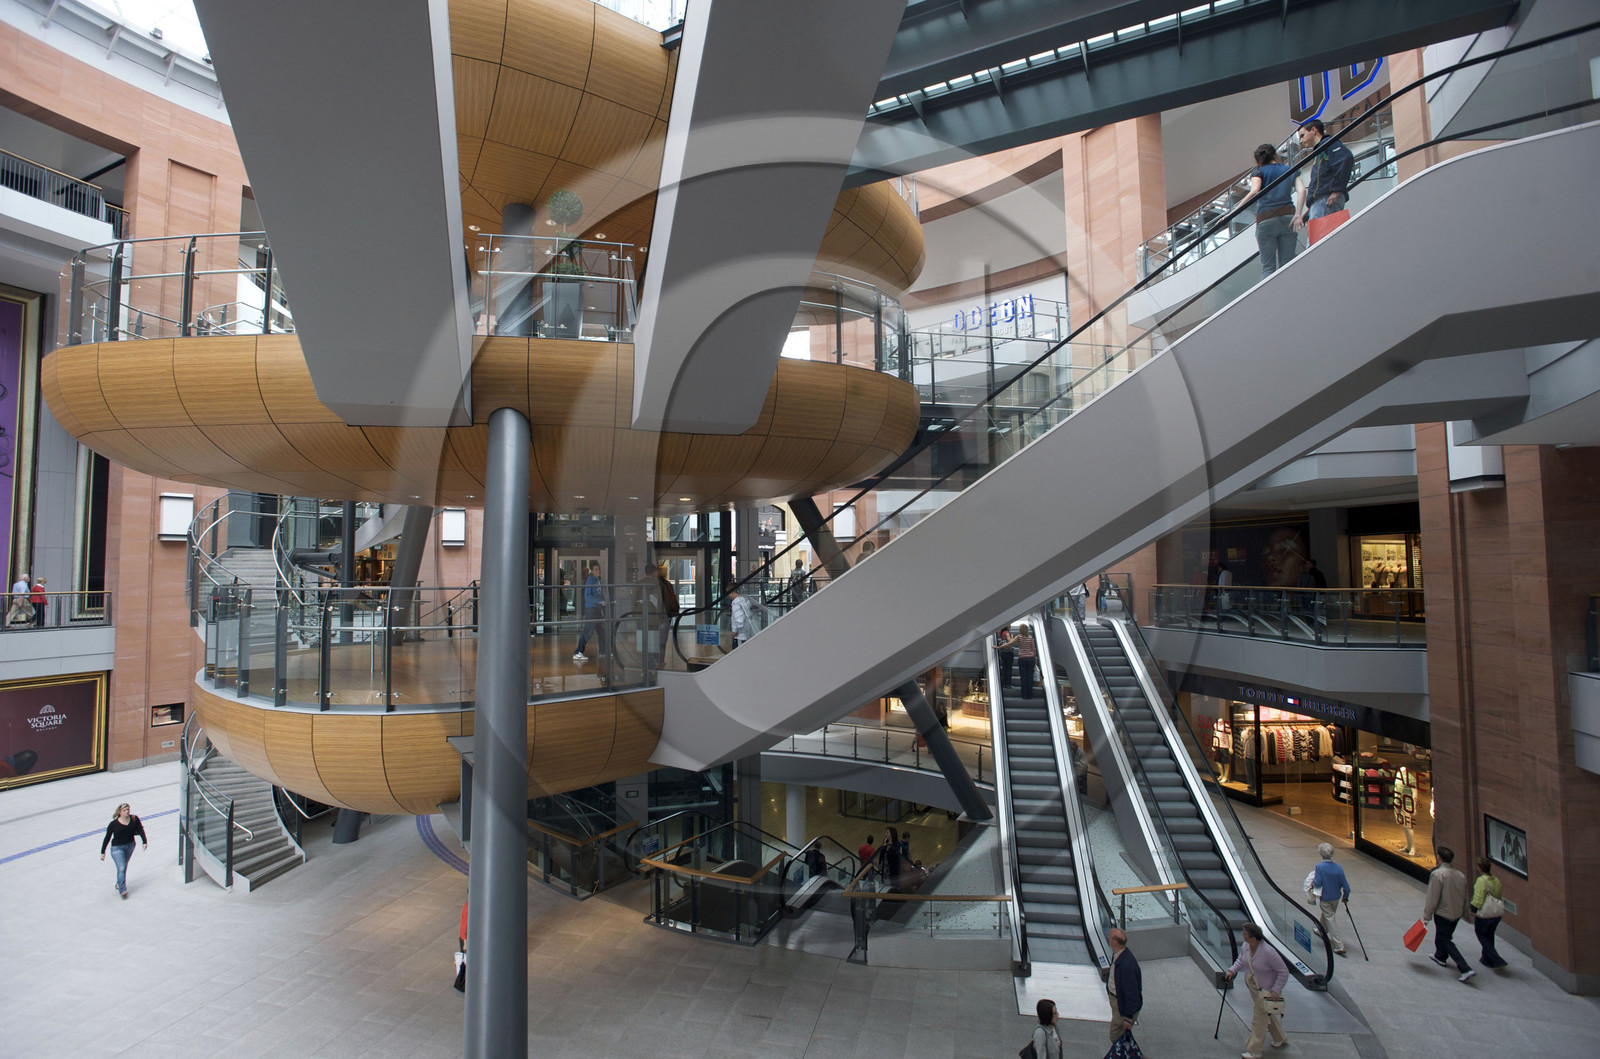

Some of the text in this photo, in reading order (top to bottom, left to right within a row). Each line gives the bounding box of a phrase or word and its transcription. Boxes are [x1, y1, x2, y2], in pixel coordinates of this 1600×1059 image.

[951, 294, 1032, 332] ODEON
[1238, 686, 1357, 720] TOMMY HILFIGER
[27, 713, 67, 724] VICTORIA
[31, 719, 63, 729] SQUARE
[1381, 761, 1426, 793] SALE
[1396, 813, 1416, 829] OFF
